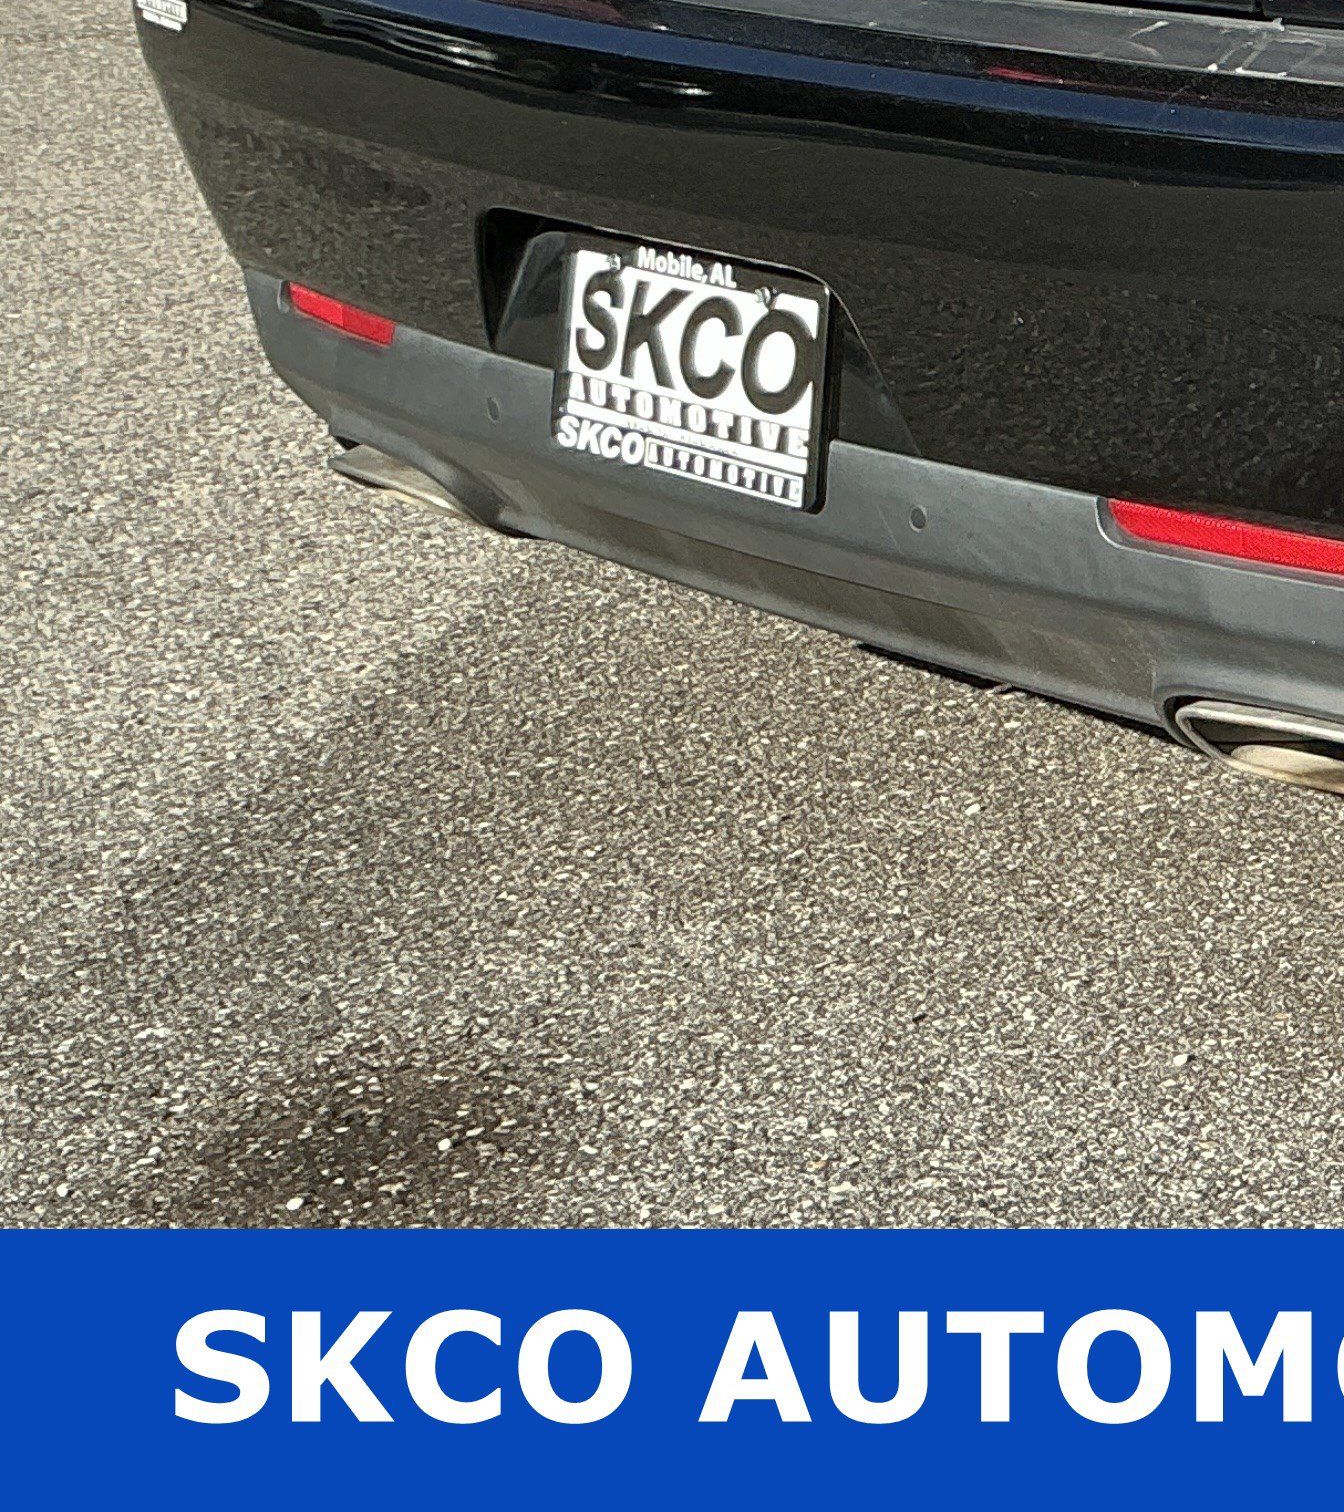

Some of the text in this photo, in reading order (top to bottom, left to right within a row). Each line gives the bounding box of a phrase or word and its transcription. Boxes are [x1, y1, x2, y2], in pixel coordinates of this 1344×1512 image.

[637, 246, 737, 288] Mobile, AL
[575, 269, 816, 415] SKCO
[569, 372, 809, 458] AUTOMOTIVE
[556, 415, 646, 465] SKCO
[648, 442, 801, 502] AUTOMOTIVE
